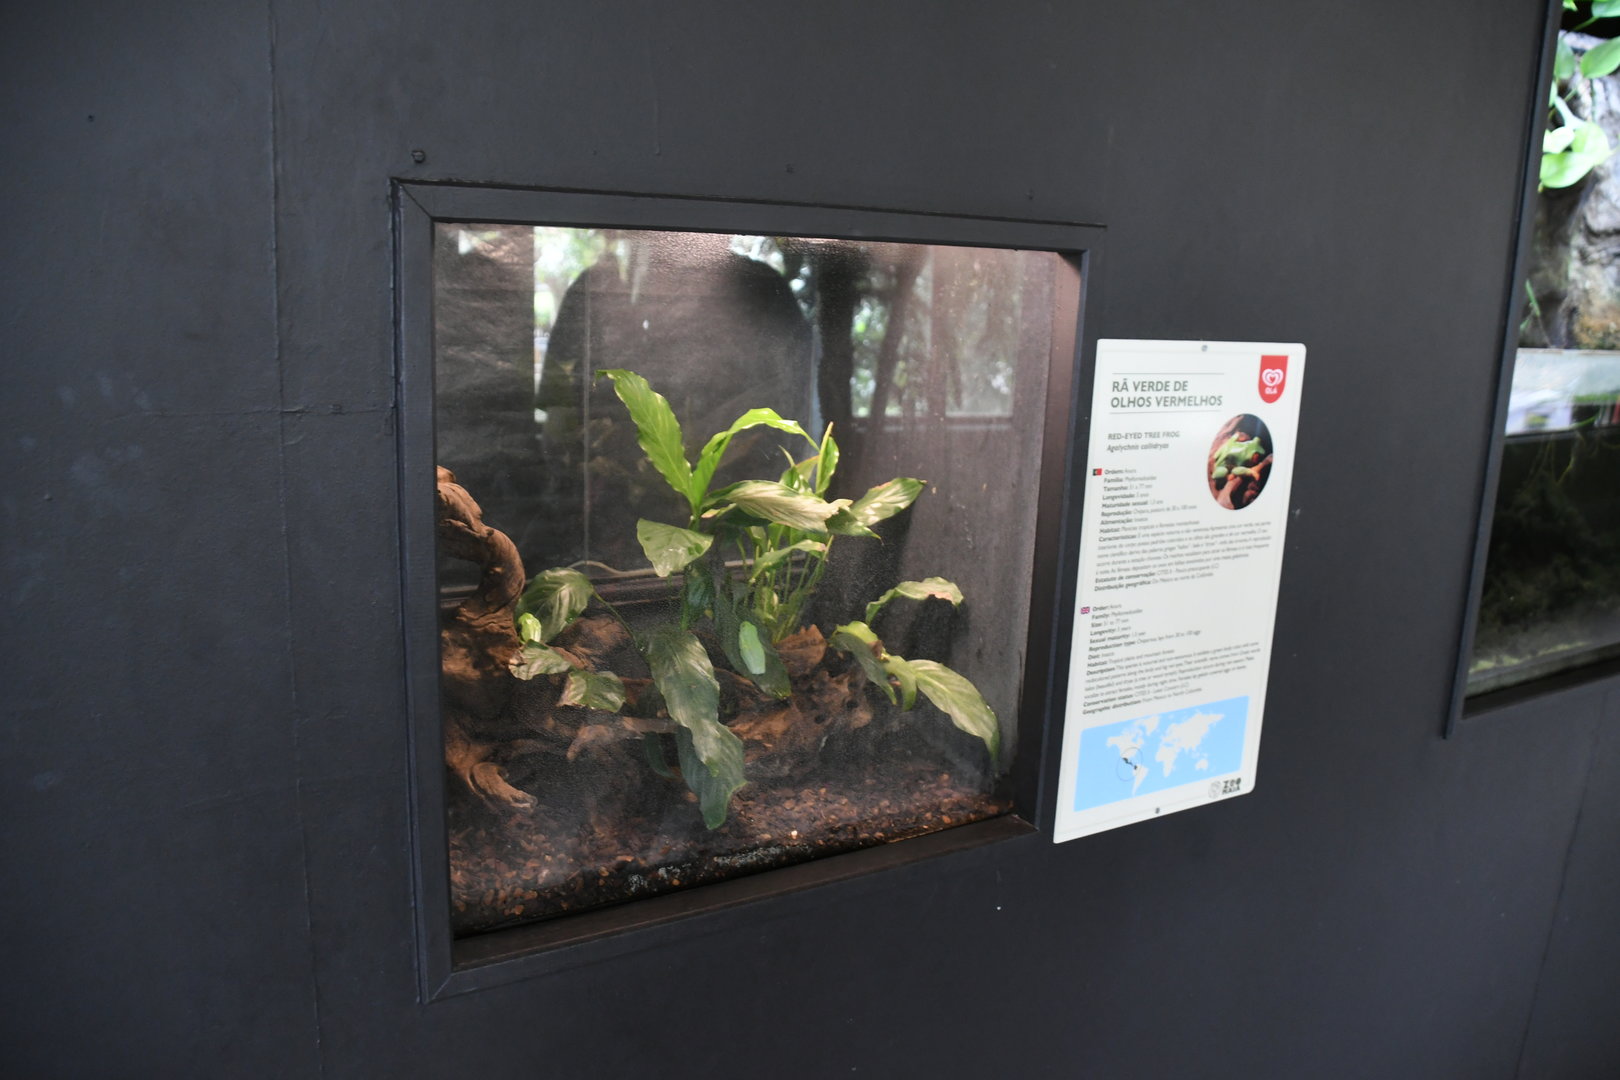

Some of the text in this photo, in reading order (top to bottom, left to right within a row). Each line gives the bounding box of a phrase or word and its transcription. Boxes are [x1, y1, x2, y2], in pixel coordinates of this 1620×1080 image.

[1112, 378, 1188, 392] RÃ VERDE DE
[1110, 395, 1223, 408] OLHOS VERMELHOS
[1107, 432, 1142, 440] RED-EYED
[1144, 431, 1160, 439] TREE
